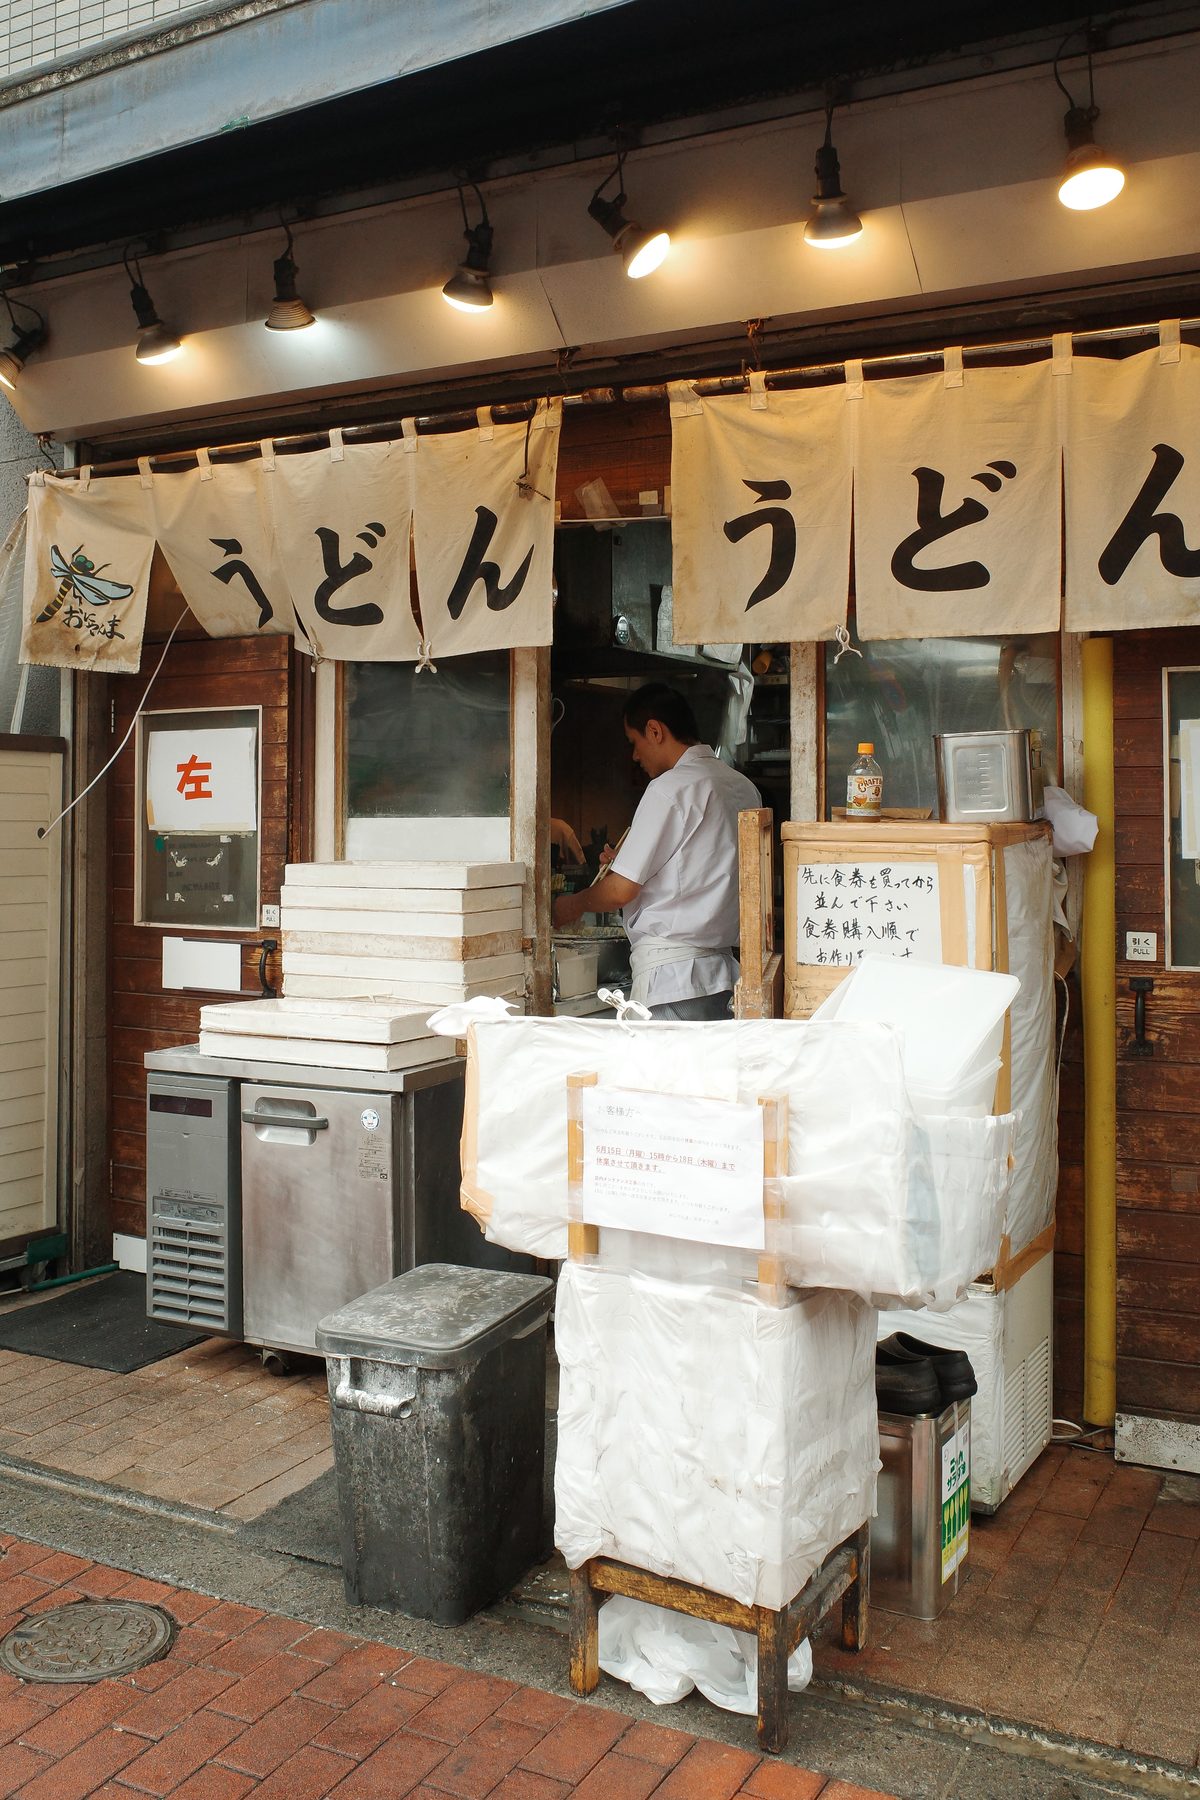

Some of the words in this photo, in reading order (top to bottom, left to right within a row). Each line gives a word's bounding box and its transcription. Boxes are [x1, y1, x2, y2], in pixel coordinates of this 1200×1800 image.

[724, 444, 1200, 612] うどん
[210, 506, 535, 628] うどん
[62, 606, 126, 640] おにやんま
[176, 754, 213, 800] 左
[801, 866, 934, 893] 先に食券を買ってから
[814, 891, 908, 913] 並んで下さい
[802, 916, 920, 942] 食券購入順で
[1131, 937, 1151, 946] 引く
[1132, 947, 1151, 955] PULL
